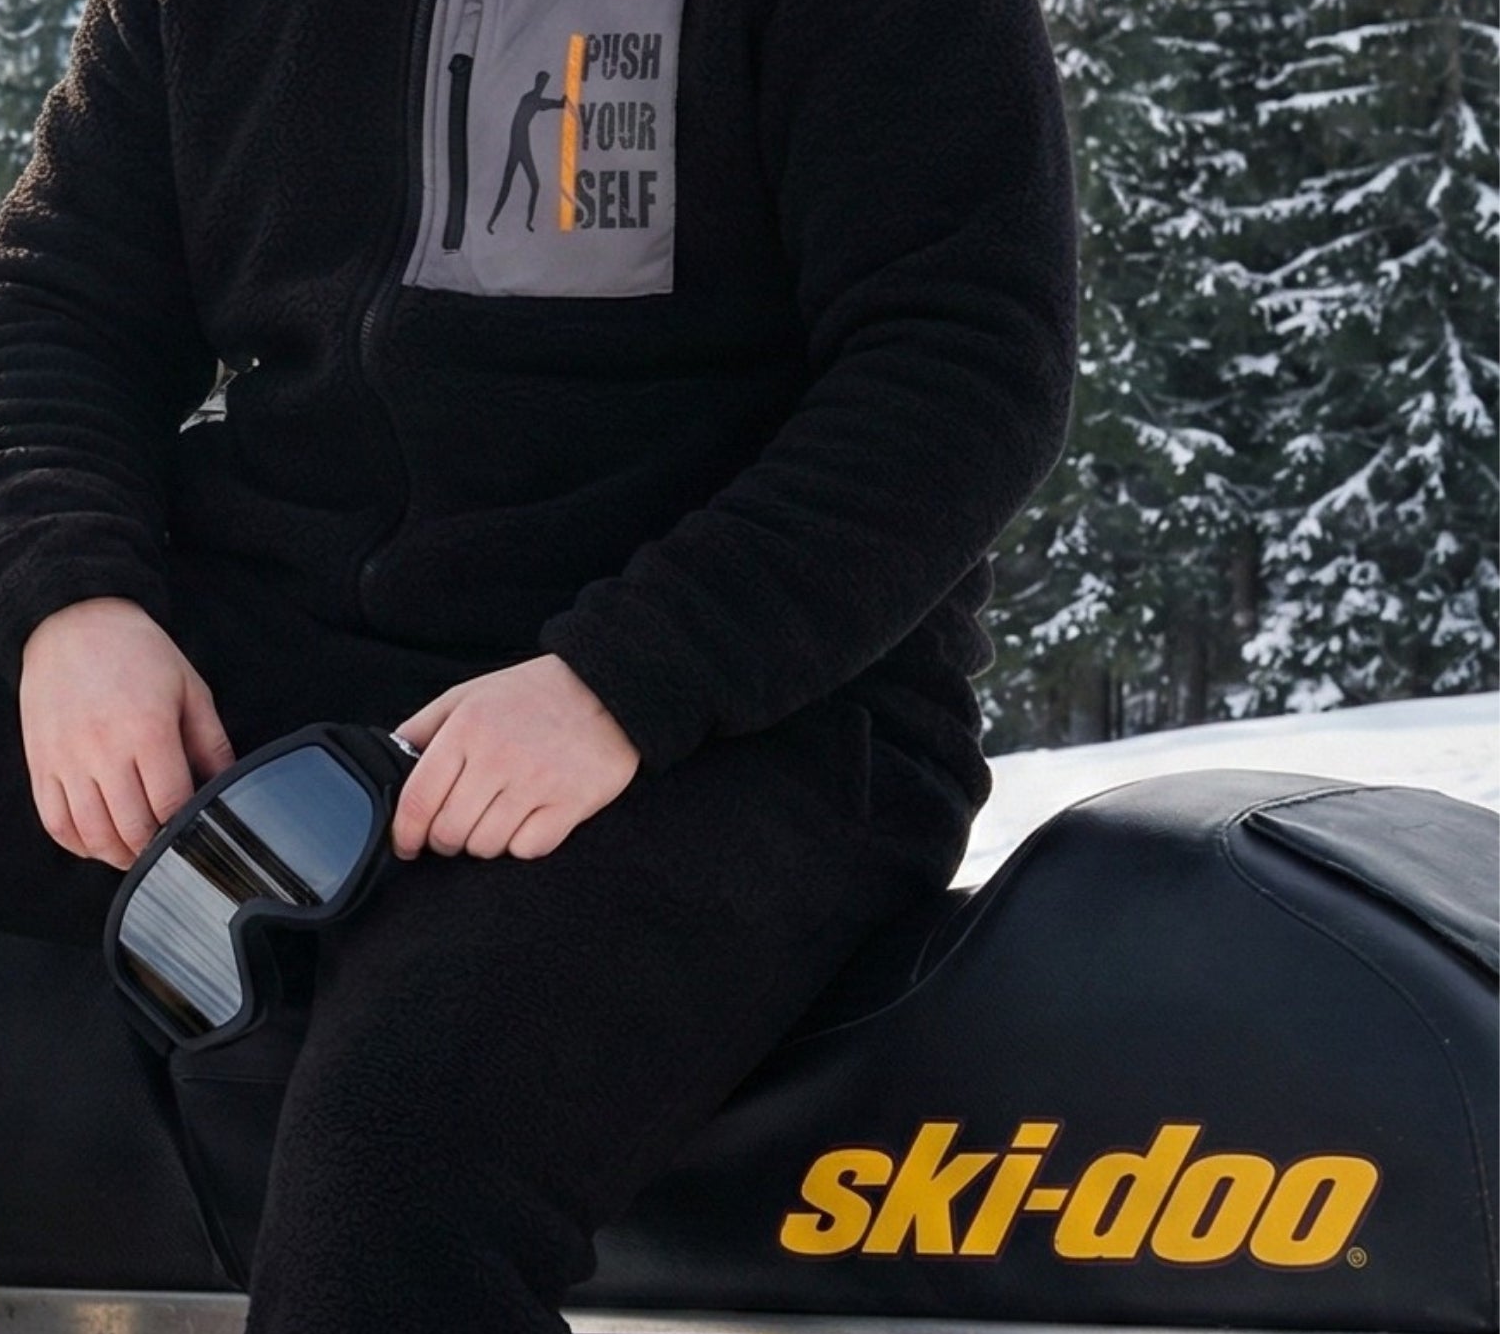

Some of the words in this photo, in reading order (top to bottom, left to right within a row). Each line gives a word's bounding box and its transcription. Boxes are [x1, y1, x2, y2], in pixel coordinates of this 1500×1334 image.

[582, 33, 662, 81] PUSH
[579, 102, 657, 151] YOUR
[574, 169, 658, 229] SELF
[779, 1122, 1380, 1267] ski-doo
